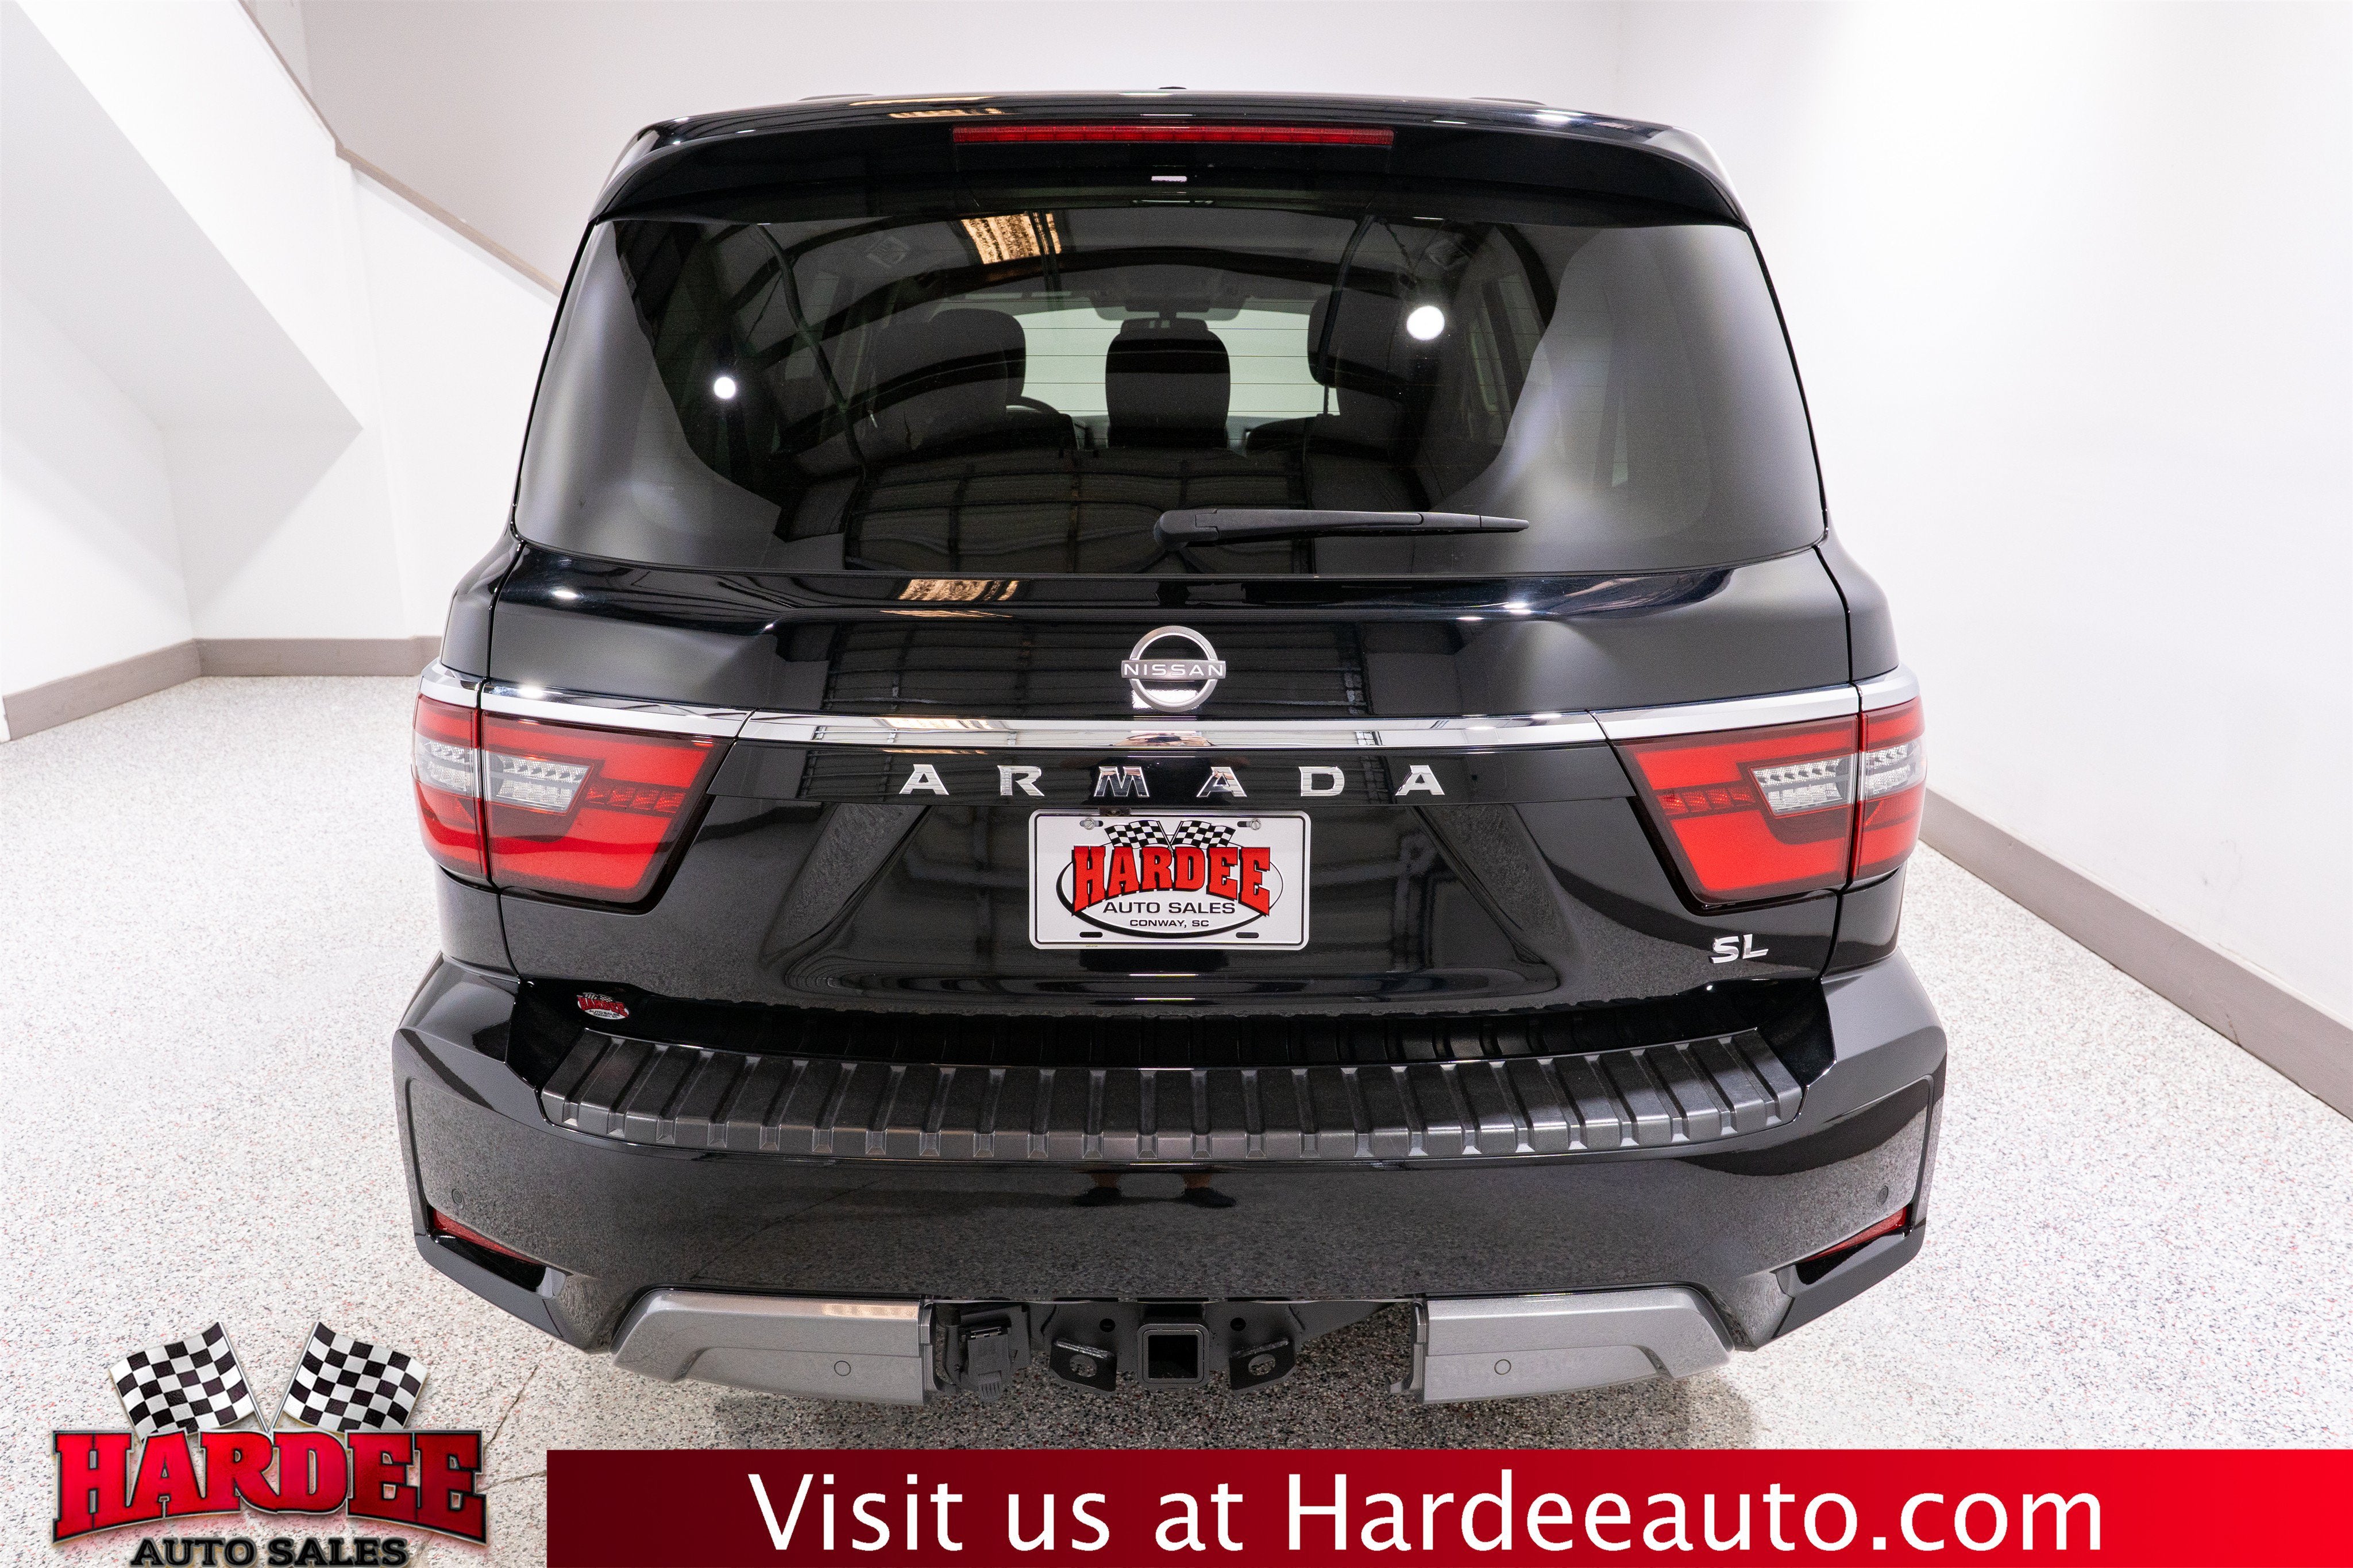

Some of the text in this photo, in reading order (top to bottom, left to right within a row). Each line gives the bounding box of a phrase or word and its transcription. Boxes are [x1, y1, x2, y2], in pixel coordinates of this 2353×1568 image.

[1124, 663, 1224, 677] NISSAN
[899, 763, 1445, 798] ARMADA
[1071, 845, 1271, 917] HARDEE
[1102, 902, 1236, 914] AUTO SALES
[1129, 919, 1187, 928] CONWAY,
[1709, 933, 1769, 964] SL
[577, 996, 630, 1018] HARDEE
